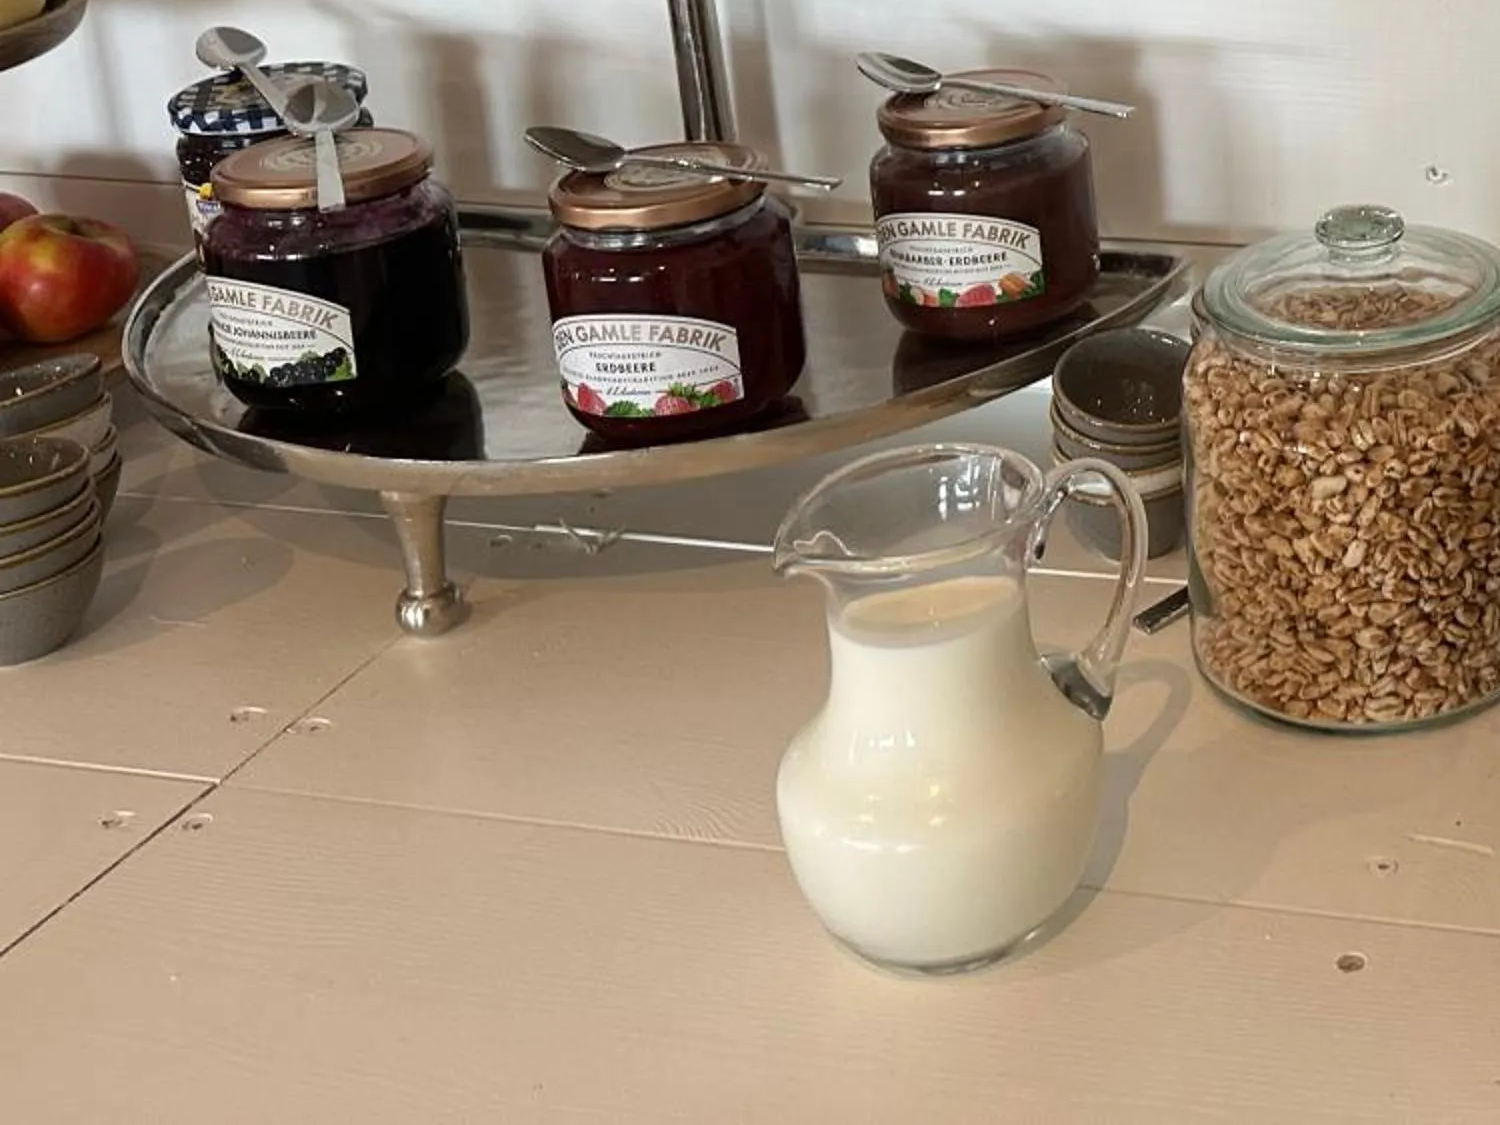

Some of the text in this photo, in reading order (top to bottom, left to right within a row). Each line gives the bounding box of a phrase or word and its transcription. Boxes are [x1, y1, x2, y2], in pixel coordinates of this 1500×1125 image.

[898, 220, 956, 237] GAMLE
[962, 222, 1030, 249] FABRIK
[263, 294, 339, 330] FABRIK
[575, 324, 642, 342] GAMLE
[650, 325, 727, 352] FABRIK
[596, 362, 657, 373] ERDBEERE
